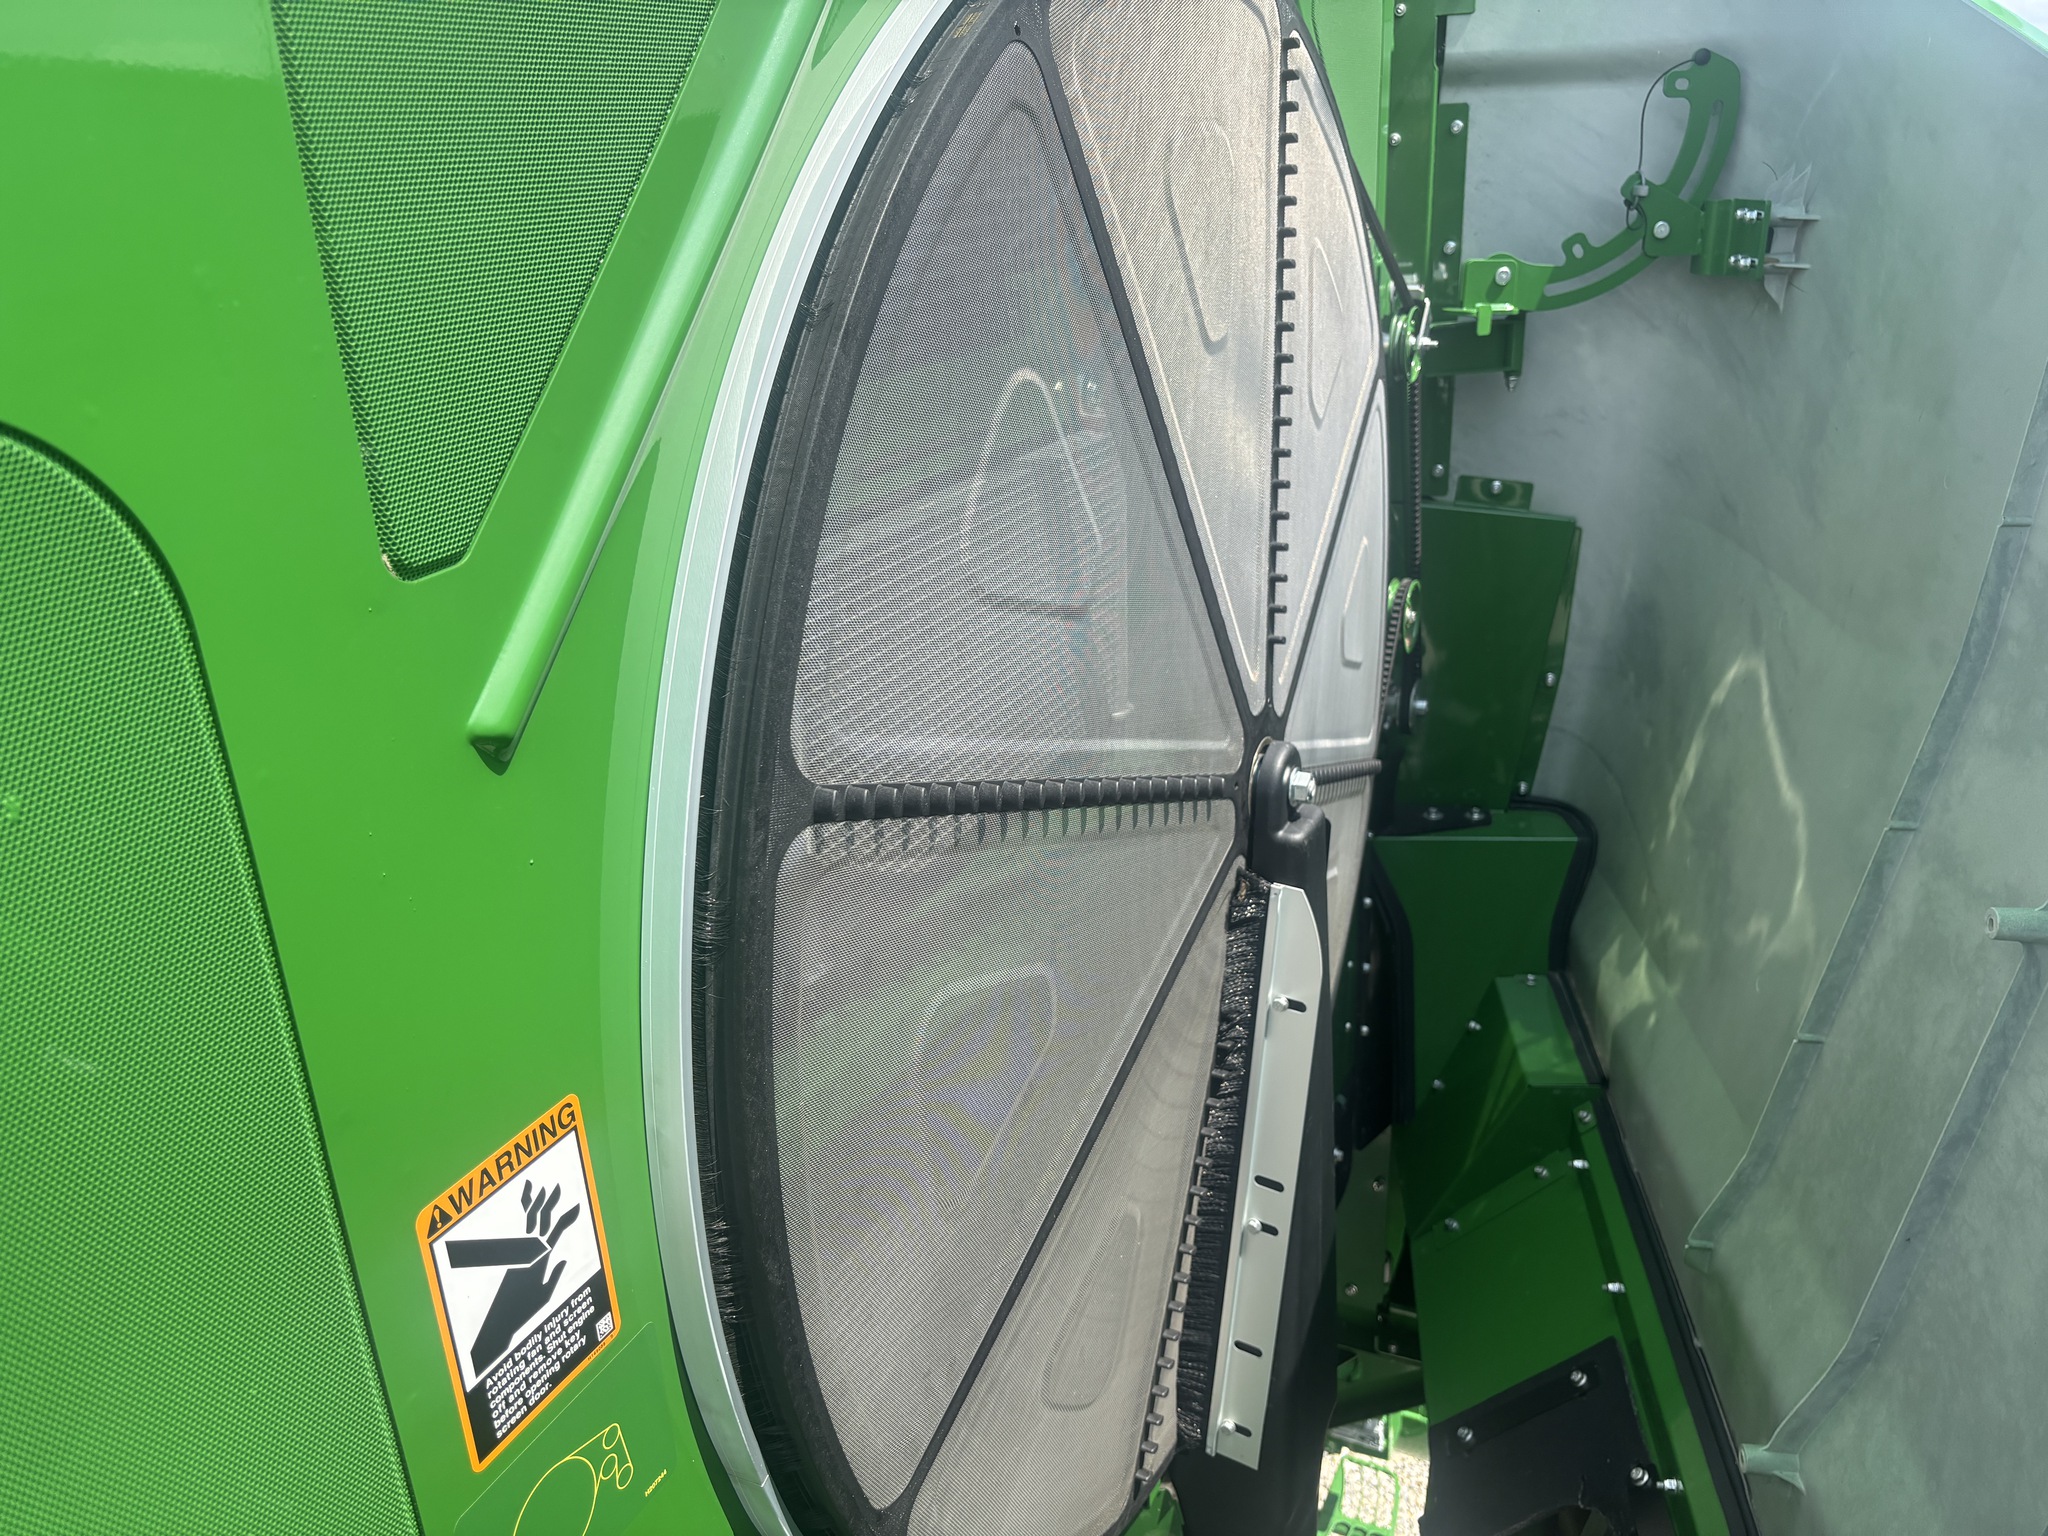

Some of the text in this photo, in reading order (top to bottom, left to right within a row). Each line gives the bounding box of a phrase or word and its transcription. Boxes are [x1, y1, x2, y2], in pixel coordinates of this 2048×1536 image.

[448, 1102, 576, 1215] WARNING
[486, 1286, 592, 1389] Avoid bodily injury from
[487, 1297, 593, 1399] rotating fan and screen
[489, 1305, 595, 1409] components. Shut engine
[491, 1329, 581, 1419] off and remove key
[493, 1335, 587, 1430] before opening rotary
[496, 1382, 553, 1439] screen door.
